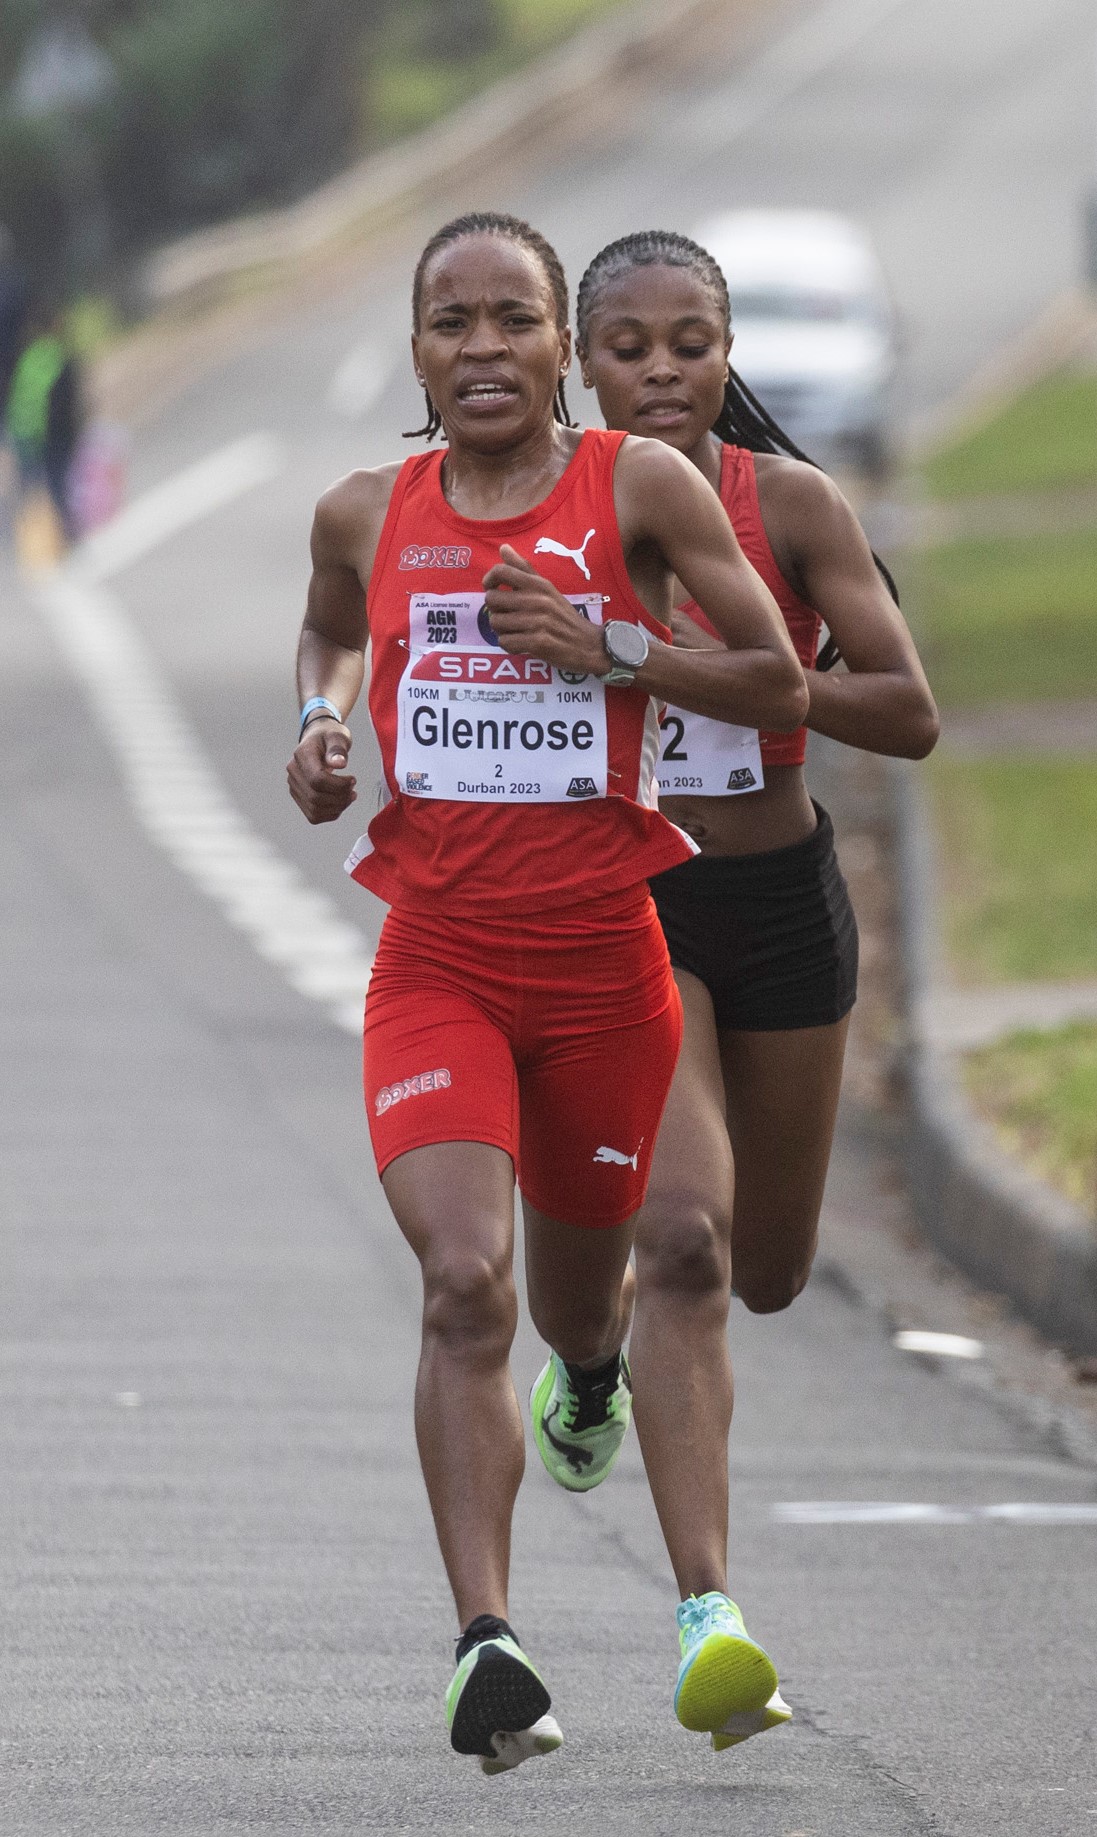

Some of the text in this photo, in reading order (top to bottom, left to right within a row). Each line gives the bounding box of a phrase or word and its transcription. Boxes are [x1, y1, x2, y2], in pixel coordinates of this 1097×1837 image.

[398, 545, 472, 570] BOXER
[426, 610, 457, 625] AGN
[427, 627, 457, 644] 2023
[439, 656, 549, 680] SPAR
[407, 687, 440, 700] 10KM
[556, 691, 593, 703] 10KM
[412, 705, 594, 751] Glenrose
[494, 763, 503, 778] 2
[730, 770, 752, 781] ASA
[457, 782, 541, 796] Durban 2023
[570, 779, 595, 790] ASA
[674, 777, 703, 788] 2023
[375, 1068, 452, 1116] BOXER
